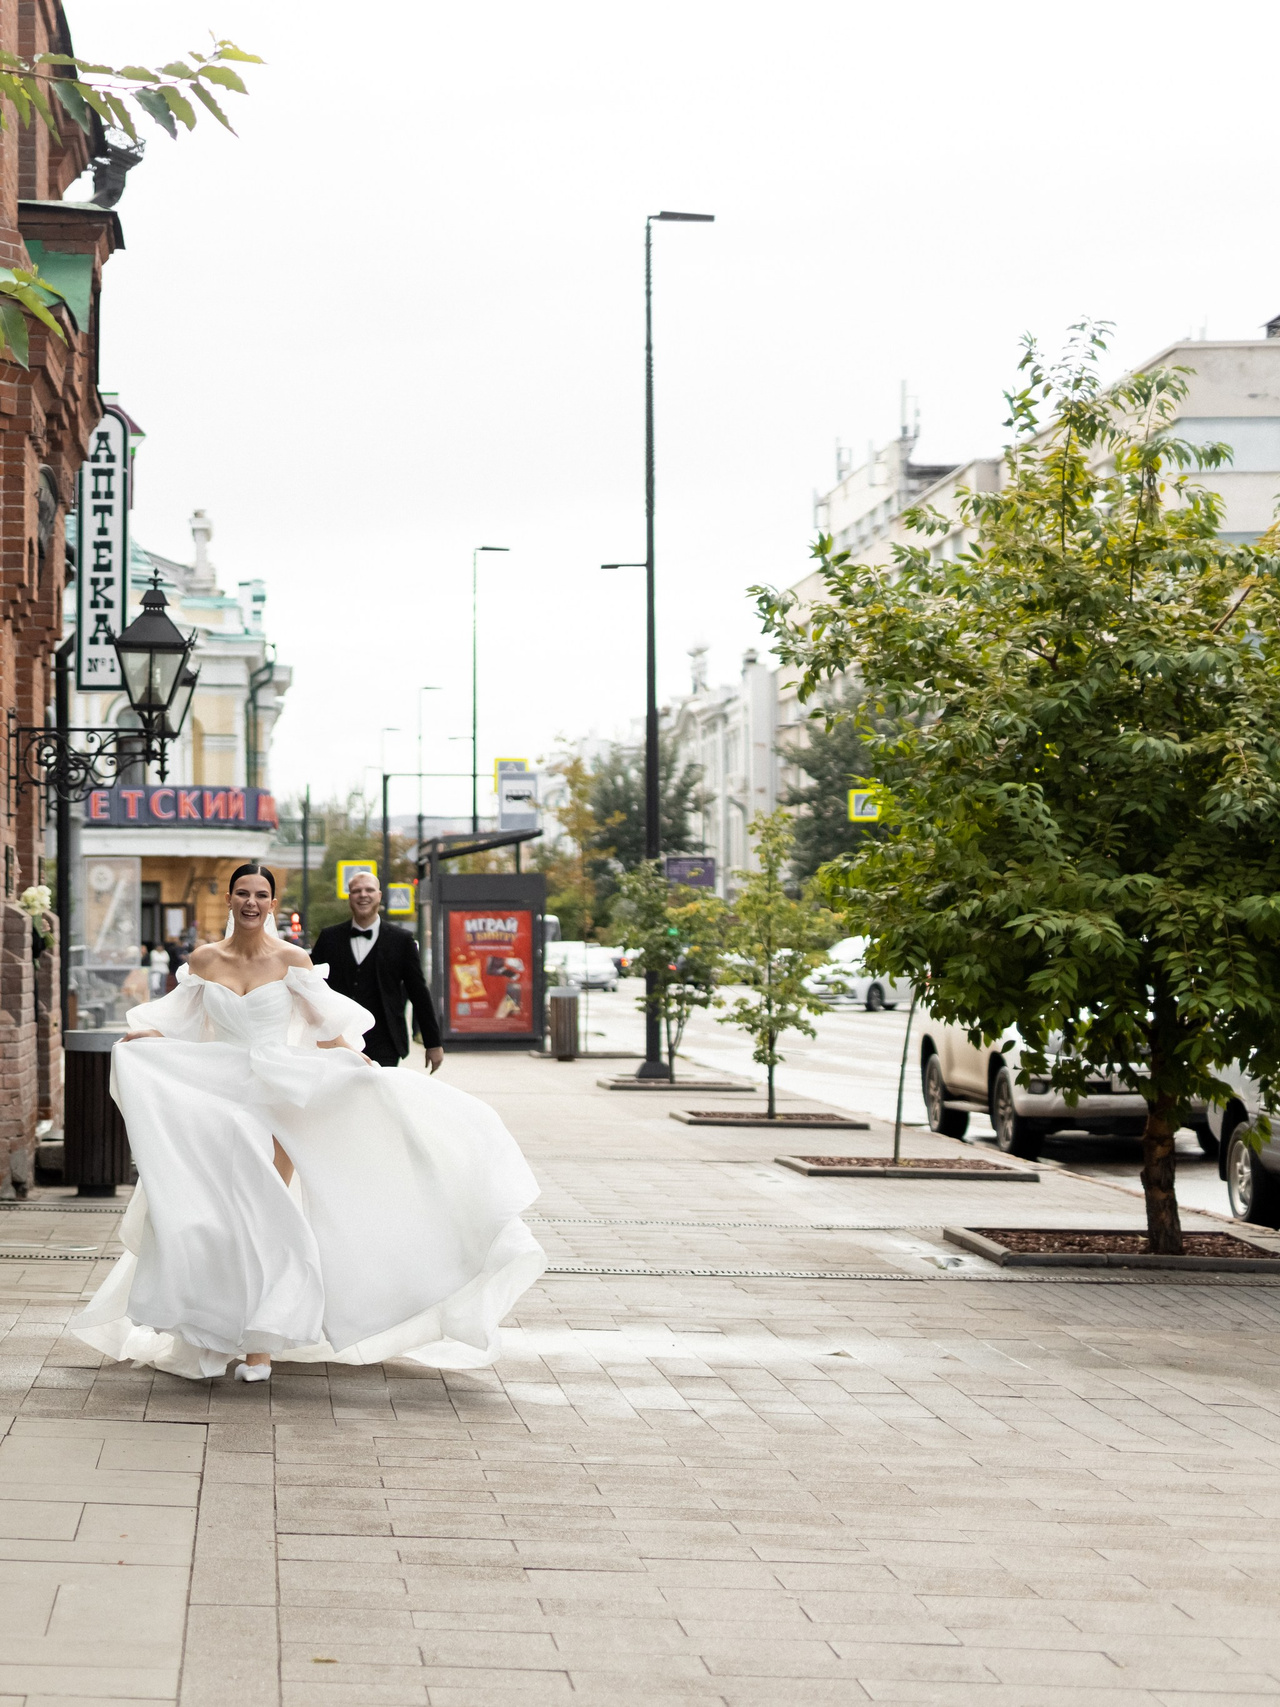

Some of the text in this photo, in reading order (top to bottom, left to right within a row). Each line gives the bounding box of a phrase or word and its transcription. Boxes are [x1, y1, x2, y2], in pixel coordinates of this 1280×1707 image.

[88, 431, 117, 645] АПТЕКА
[89, 786, 247, 821] ЕТСКИЙ
[464, 916, 519, 933] ИГРАЙ
